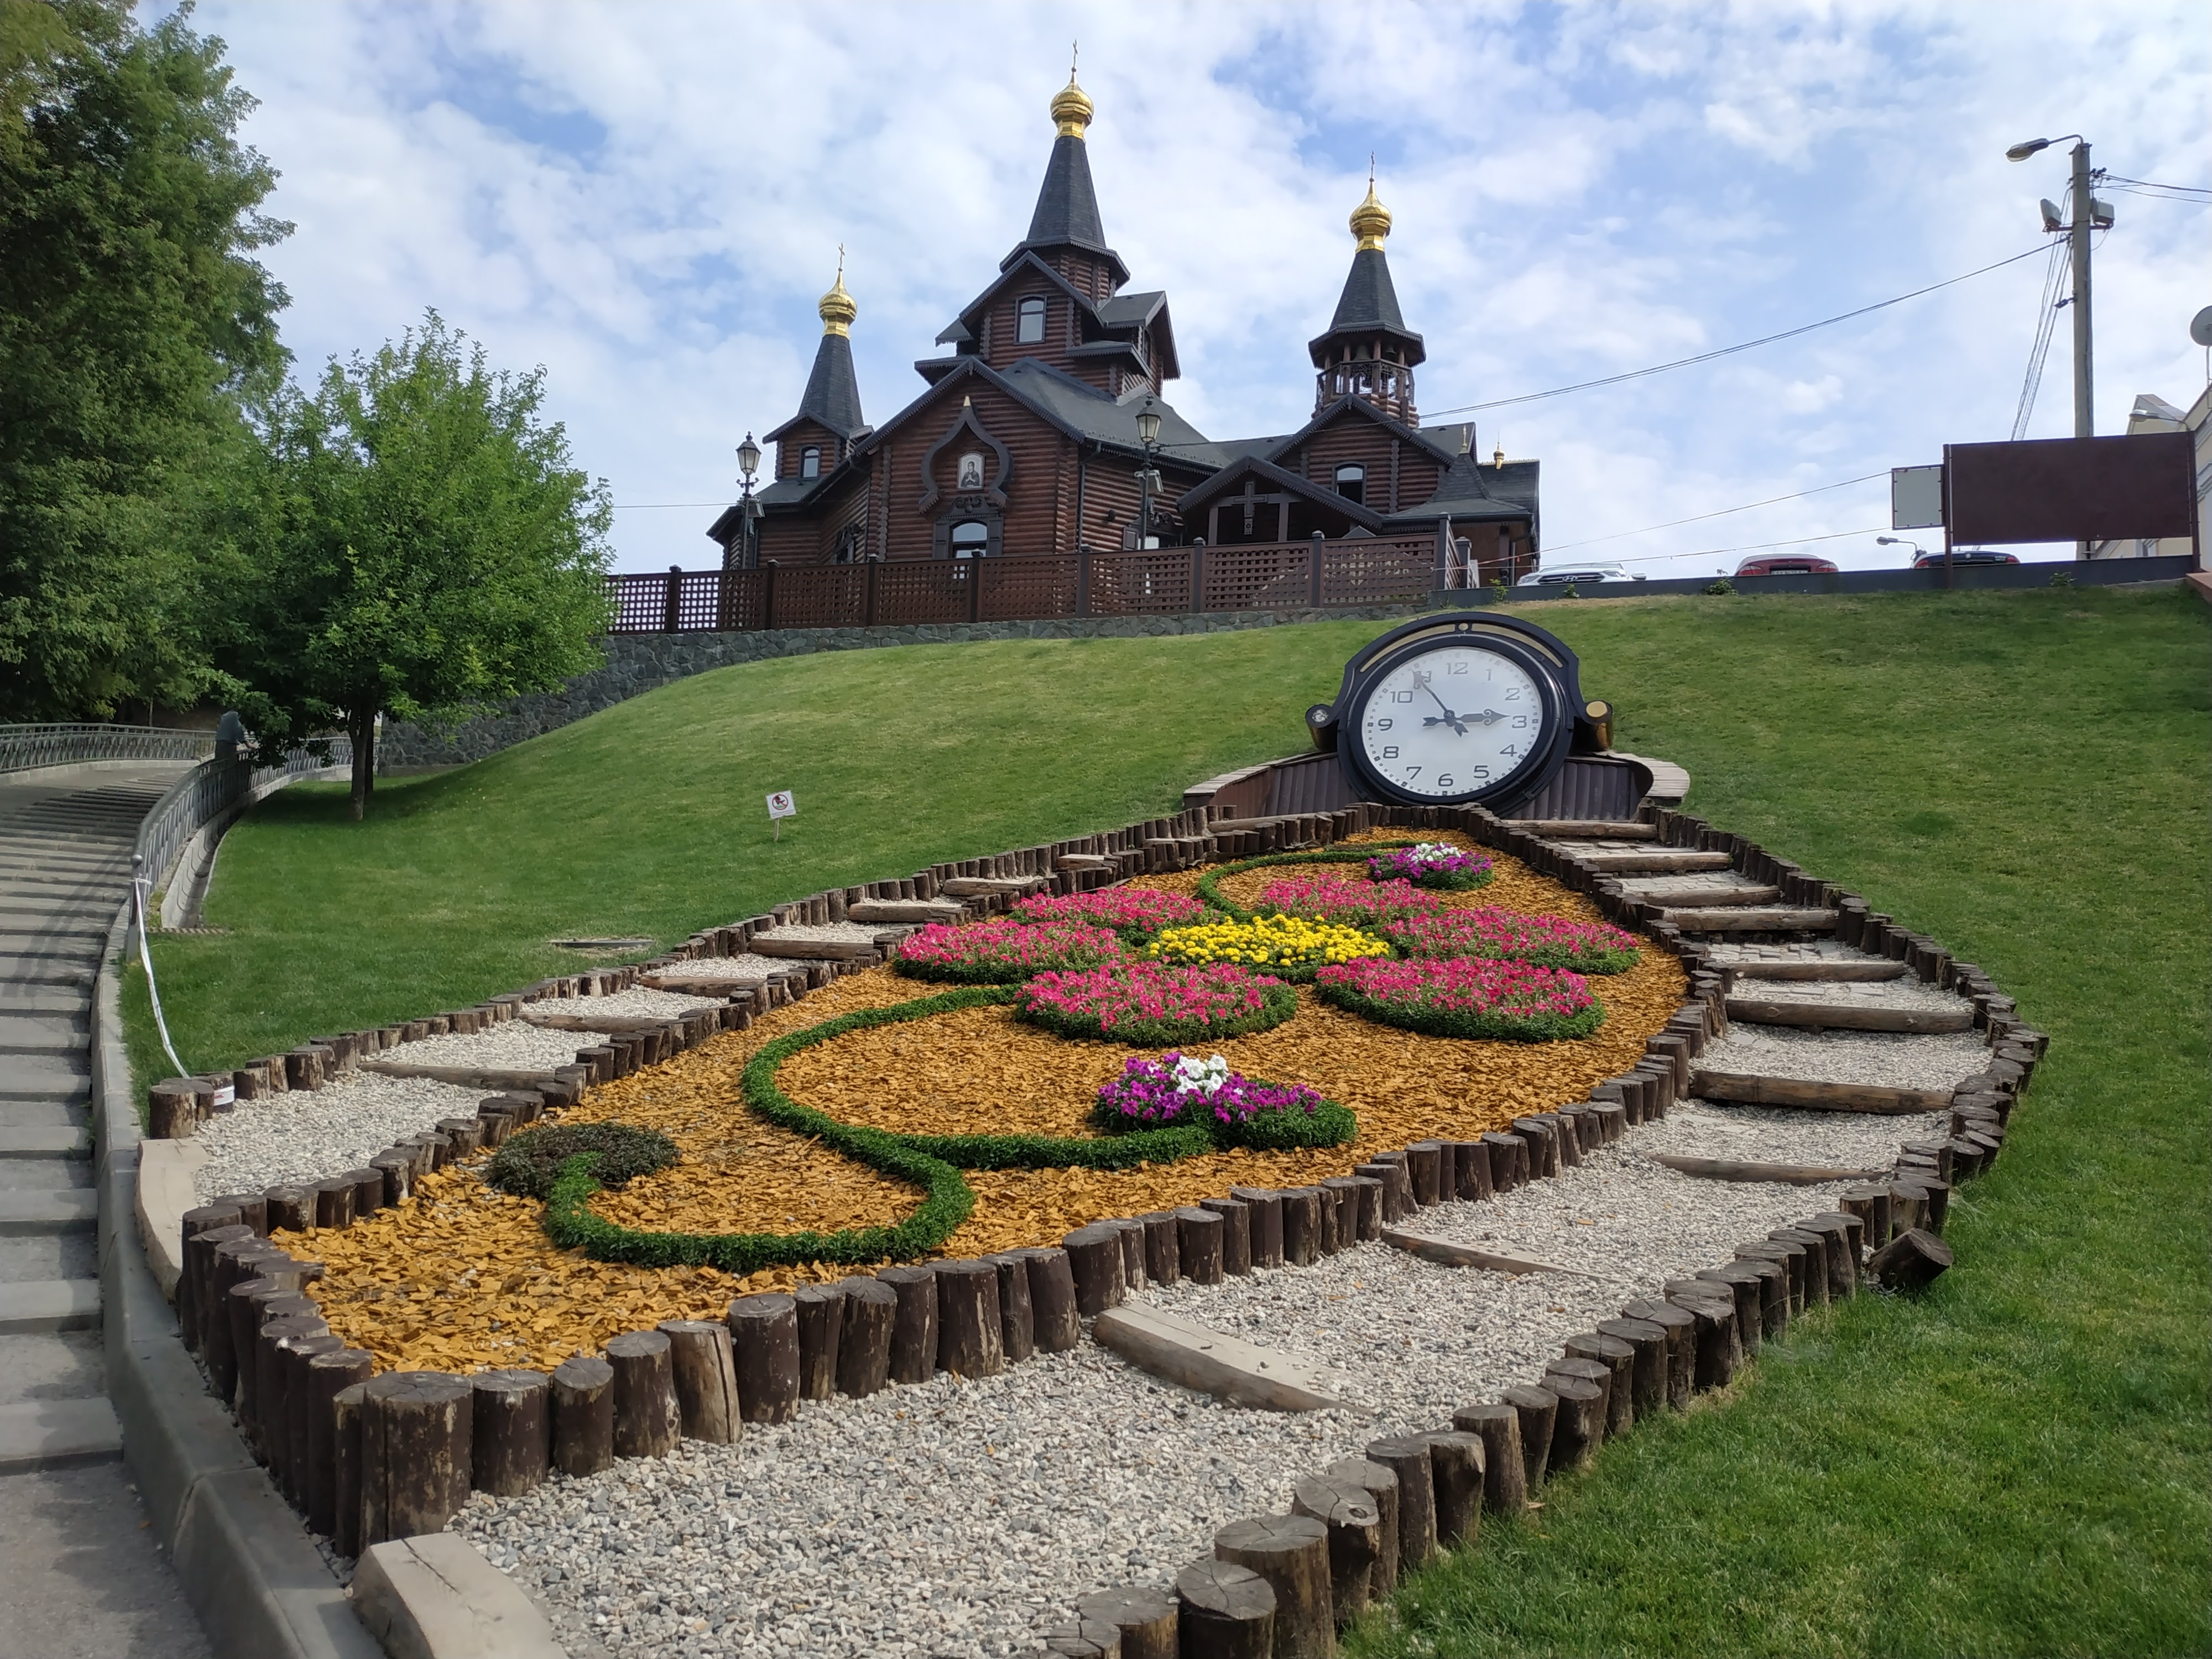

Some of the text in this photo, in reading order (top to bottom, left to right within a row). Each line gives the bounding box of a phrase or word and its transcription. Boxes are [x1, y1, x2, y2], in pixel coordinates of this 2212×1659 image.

[1446, 662, 1468, 675] 12
[1486, 669, 1491, 681] 1
[1390, 691, 1413, 703] 10
[1505, 687, 1520, 701] 2
[1378, 718, 1393, 731] 9
[1511, 715, 1527, 728] 3
[1383, 746, 1399, 759] 8
[1499, 744, 1517, 757] 4
[1406, 766, 1422, 780] 7
[1473, 765, 1489, 779] 5
[1438, 773, 1454, 787] 6
